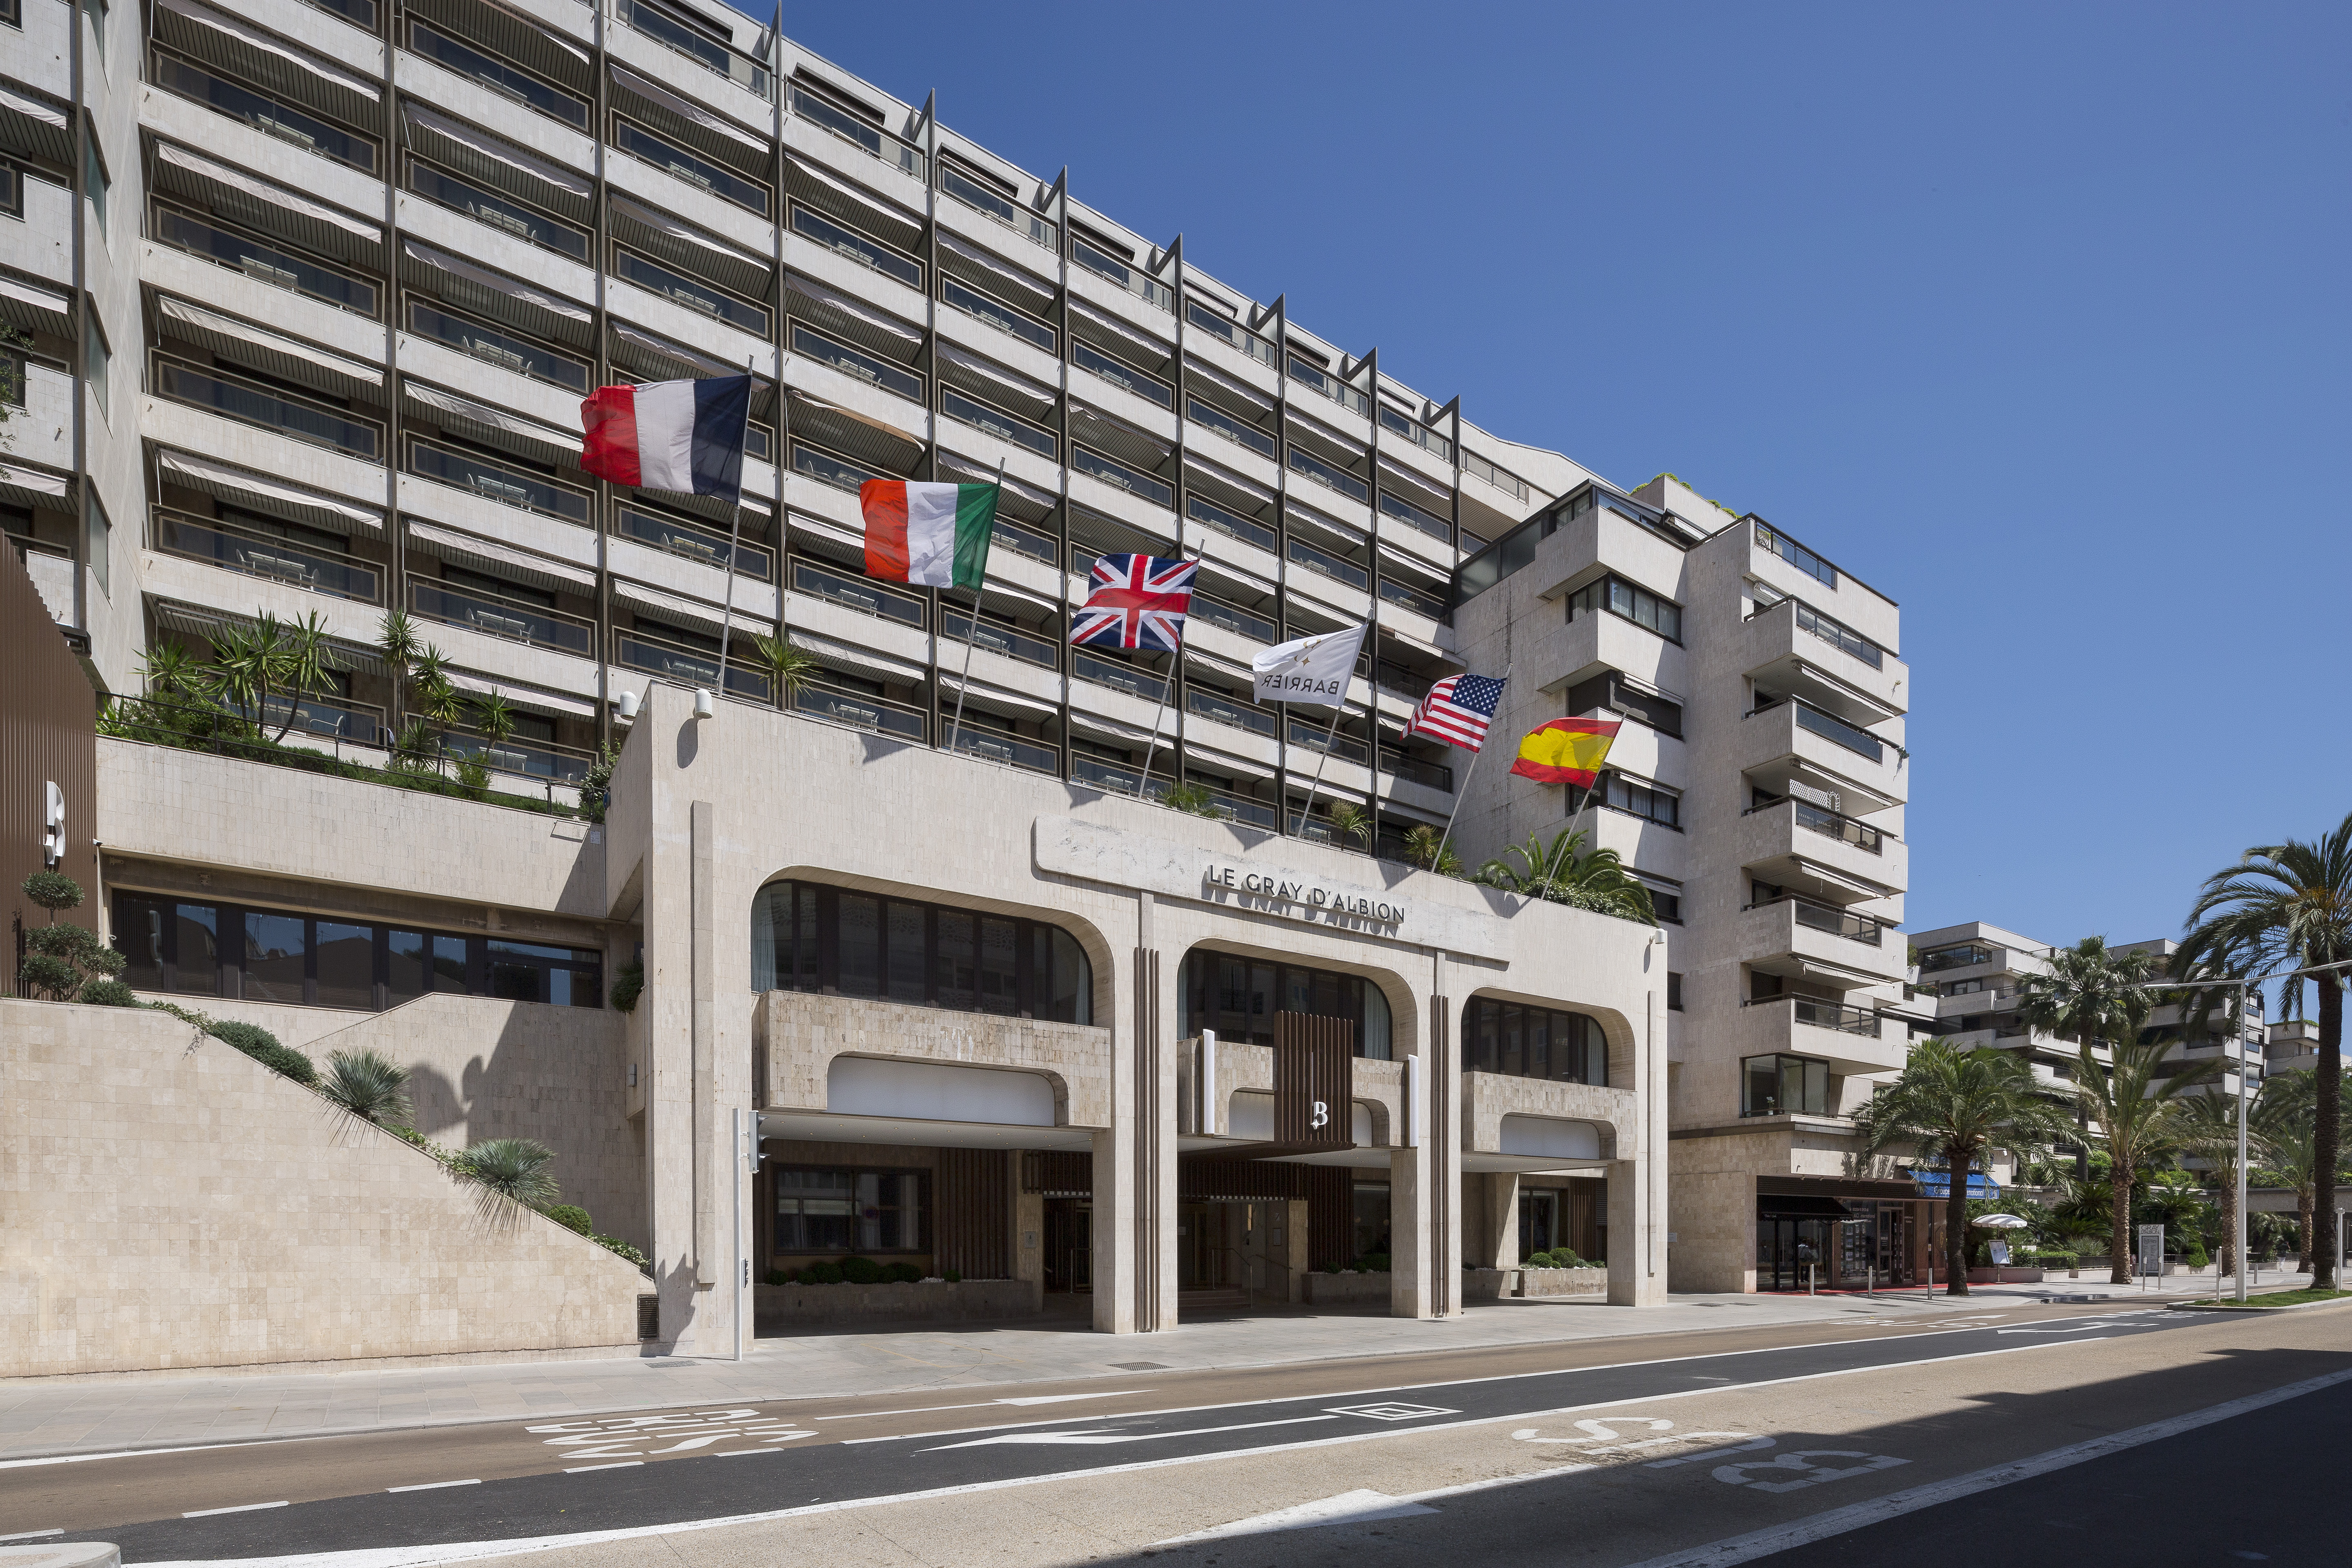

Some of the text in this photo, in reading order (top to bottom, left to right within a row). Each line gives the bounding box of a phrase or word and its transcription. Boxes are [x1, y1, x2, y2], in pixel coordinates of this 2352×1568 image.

[1208, 864, 1405, 923] LE GRAY D'ALBION
[1311, 1102, 1328, 1129] B
[1934, 1186, 1950, 1196] Groupe
[1967, 1188, 1984, 1196] rnational
[1828, 1320, 1988, 1328] BUS
[525, 1409, 819, 1459] BUS
[1511, 1417, 1914, 1493] BUS
